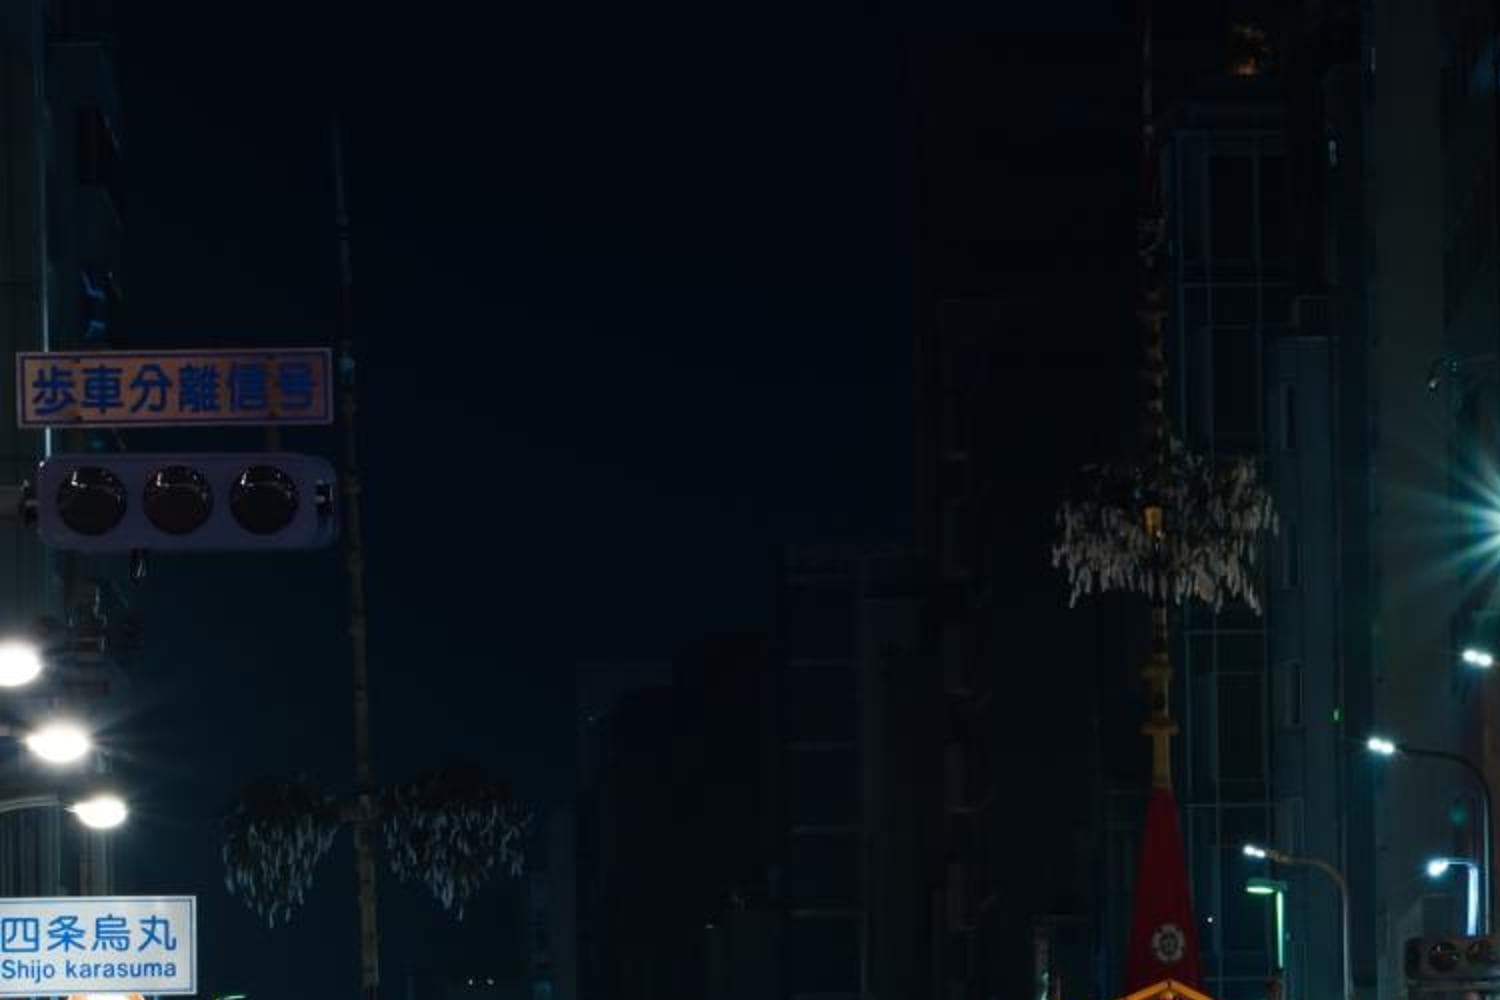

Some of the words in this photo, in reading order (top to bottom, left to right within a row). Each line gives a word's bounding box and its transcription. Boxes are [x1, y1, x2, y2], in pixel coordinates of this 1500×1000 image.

[33, 363, 317, 415] 歩車分離信号
[1, 914, 177, 953] 四条烏丸
[1, 959, 56, 983] Shijo
[65, 959, 177, 979] karasuma
